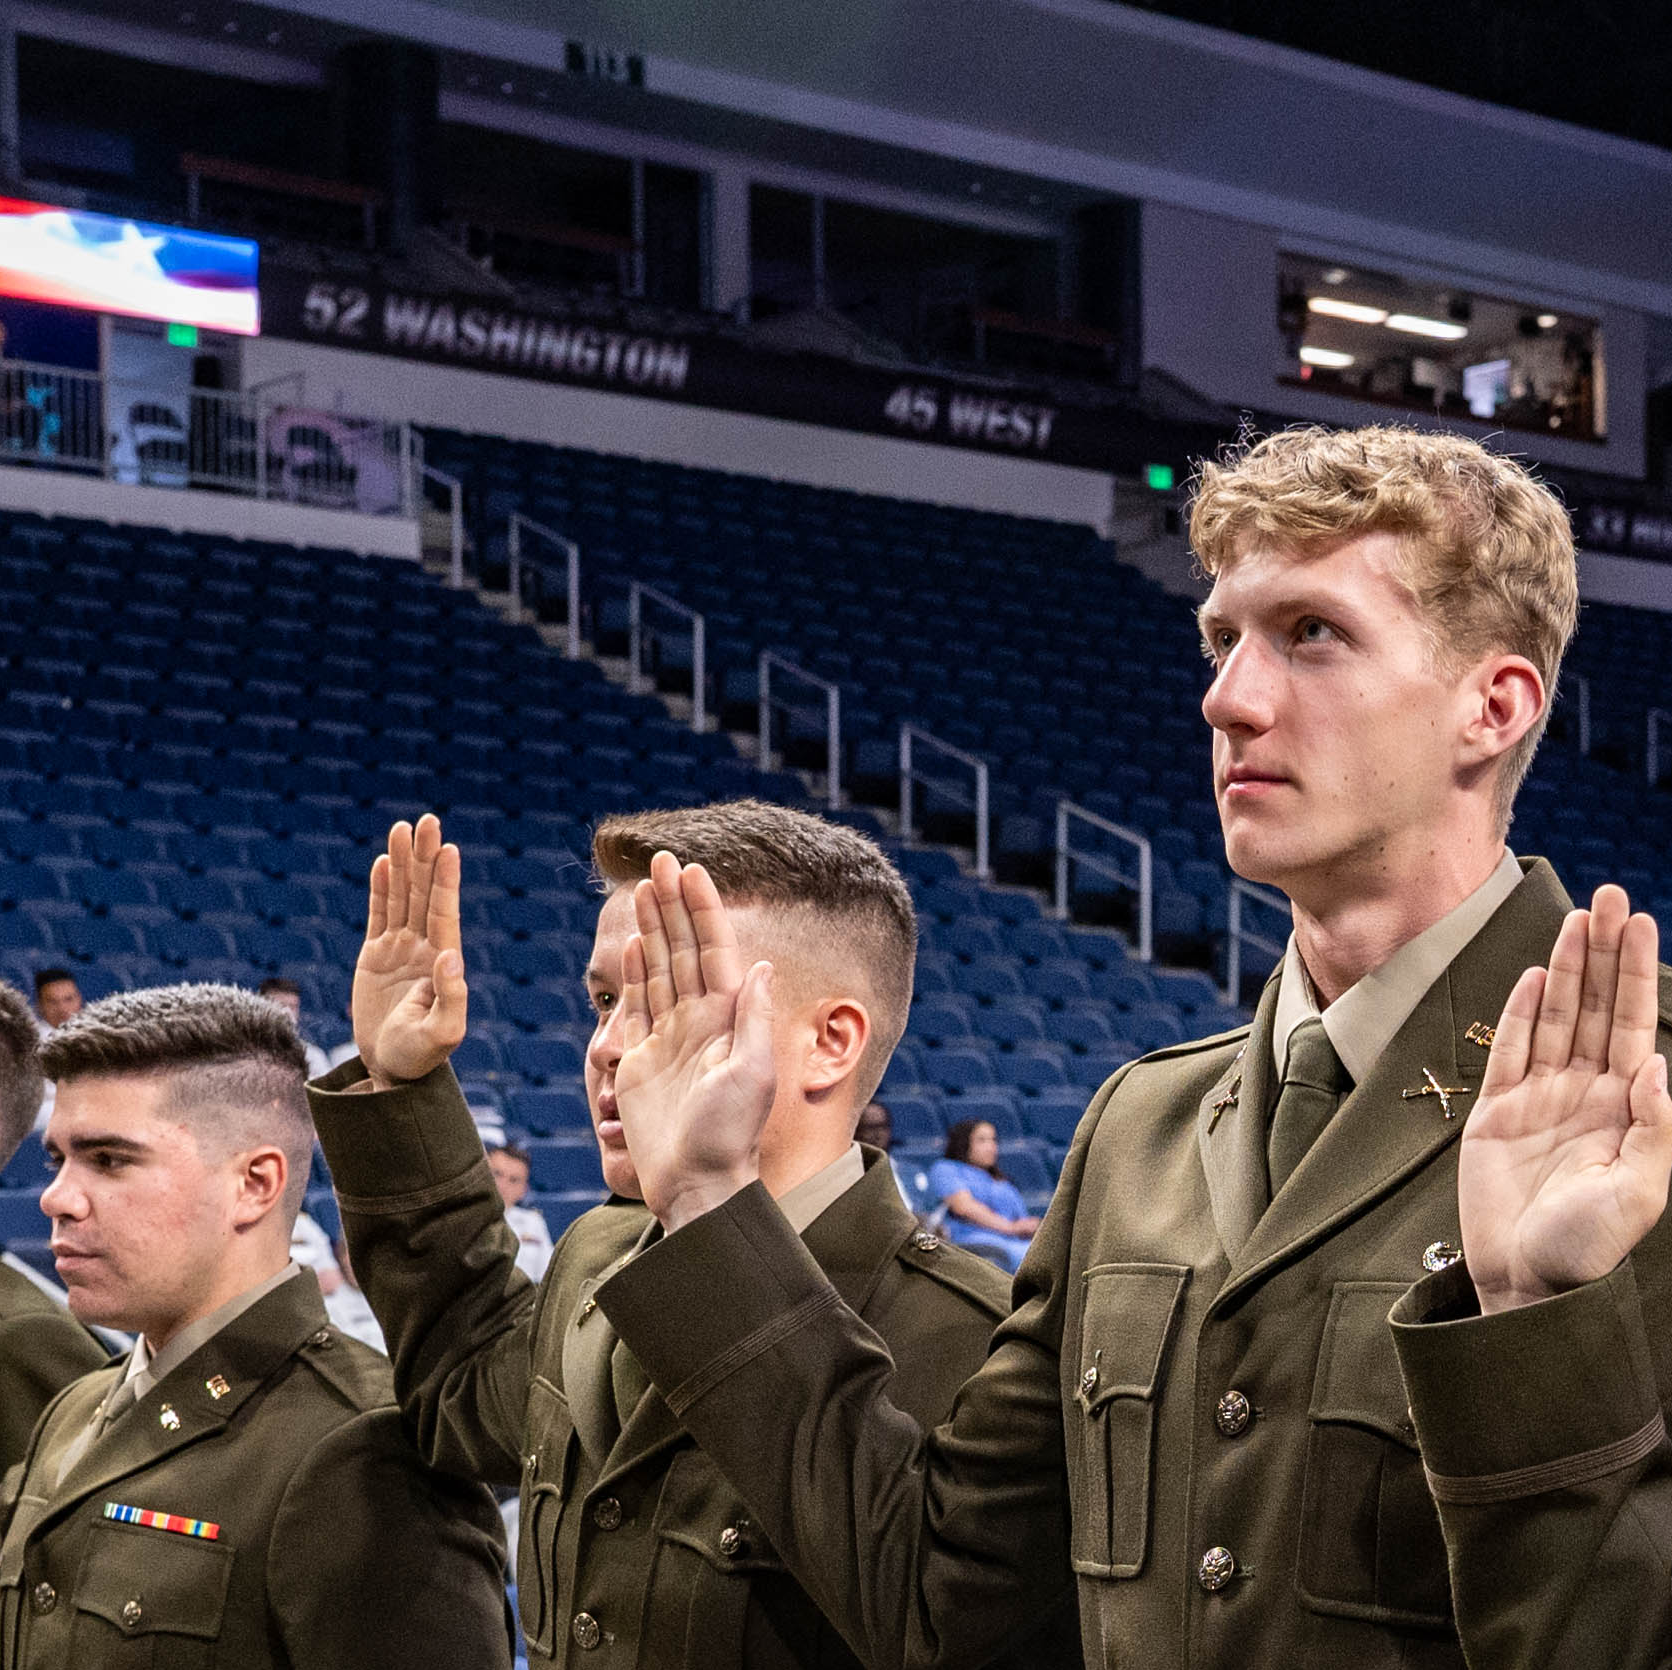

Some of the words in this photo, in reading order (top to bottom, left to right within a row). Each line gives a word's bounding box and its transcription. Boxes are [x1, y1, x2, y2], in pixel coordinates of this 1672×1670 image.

[303, 282, 369, 336] 52
[382, 293, 690, 390] WASHINGTON
[884, 385, 937, 431] 45
[949, 394, 1055, 450] WEST
